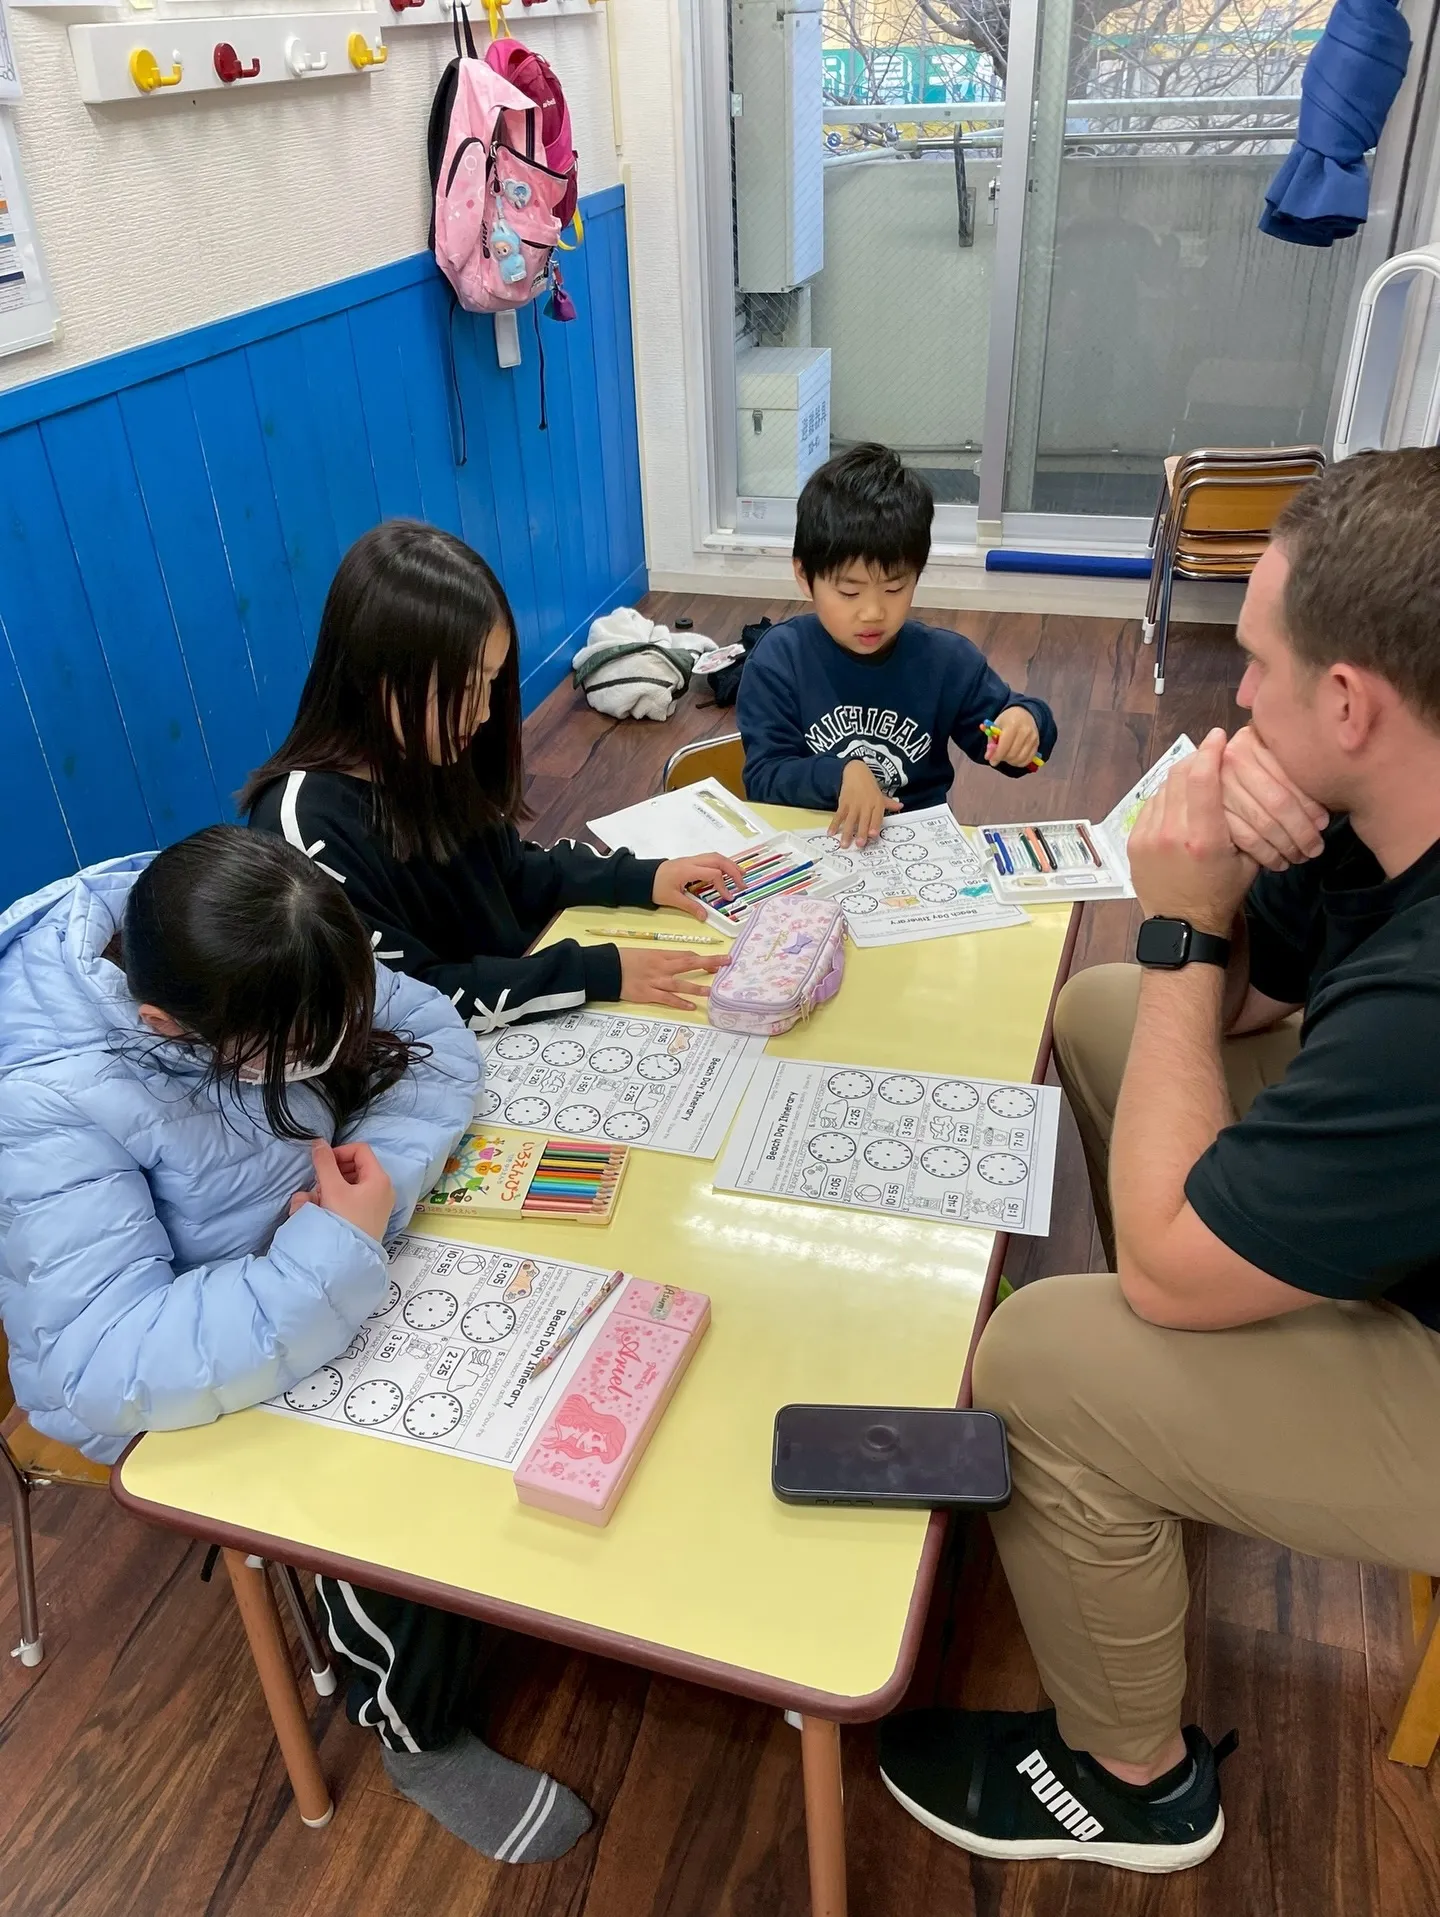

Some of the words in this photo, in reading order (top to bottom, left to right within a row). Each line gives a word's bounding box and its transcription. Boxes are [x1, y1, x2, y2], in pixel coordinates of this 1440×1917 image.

[804, 705, 933, 763] MICHIGAN
[881, 758, 898, 777] ERIE
[888, 915, 930, 925] Itinerary
[608, 1020, 627, 1036] 10:55
[656, 1028, 672, 1042] 8:05
[530, 1068, 545, 1085] 5:20
[704, 1057, 721, 1076] Beach
[575, 1076, 593, 1091] 3:50
[695, 1076, 711, 1089] Day
[622, 1085, 640, 1101] 2:25
[680, 1090, 705, 1121] Itinerary
[777, 1091, 798, 1122] Itinerary
[847, 1108, 860, 1125] 2:25
[901, 1117, 914, 1135] 3:50
[773, 1123, 787, 1137] Day
[957, 1124, 969, 1142] 5:20
[1013, 1131, 1024, 1146] 7:10
[765, 1138, 781, 1160] Beach
[501, 1141, 535, 1202] いろえんぴつ
[827, 1177, 841, 1196] 8:05
[885, 1184, 899, 1205] 10:55
[1007, 1202, 1018, 1217] 1:15
[435, 1250, 458, 1274] 10:55
[491, 1262, 513, 1284] 8:05
[531, 1271, 551, 1298] SEASHELL
[580, 1277, 598, 1297] Name
[655, 1288, 675, 1312] Asumi
[510, 1298, 536, 1335] COLLECTING
[542, 1308, 567, 1338] Beach
[378, 1334, 402, 1359] 3:50
[529, 1339, 550, 1359] Day
[347, 1351, 372, 1381] WATCHING
[435, 1351, 459, 1376] 2:25
[507, 1362, 521, 1378] beach
[607, 1336, 642, 1397] Ariel
[474, 1357, 502, 1397] SANDCASTLE
[500, 1378, 512, 1388] day
[502, 1360, 537, 1408] Itinerary
[458, 1397, 479, 1426] CONTEST
[527, 1394, 542, 1411] Telling
[521, 1412, 533, 1425] Time
[503, 1437, 520, 1459] Minutes
[1016, 1749, 1104, 1841] PUMA
